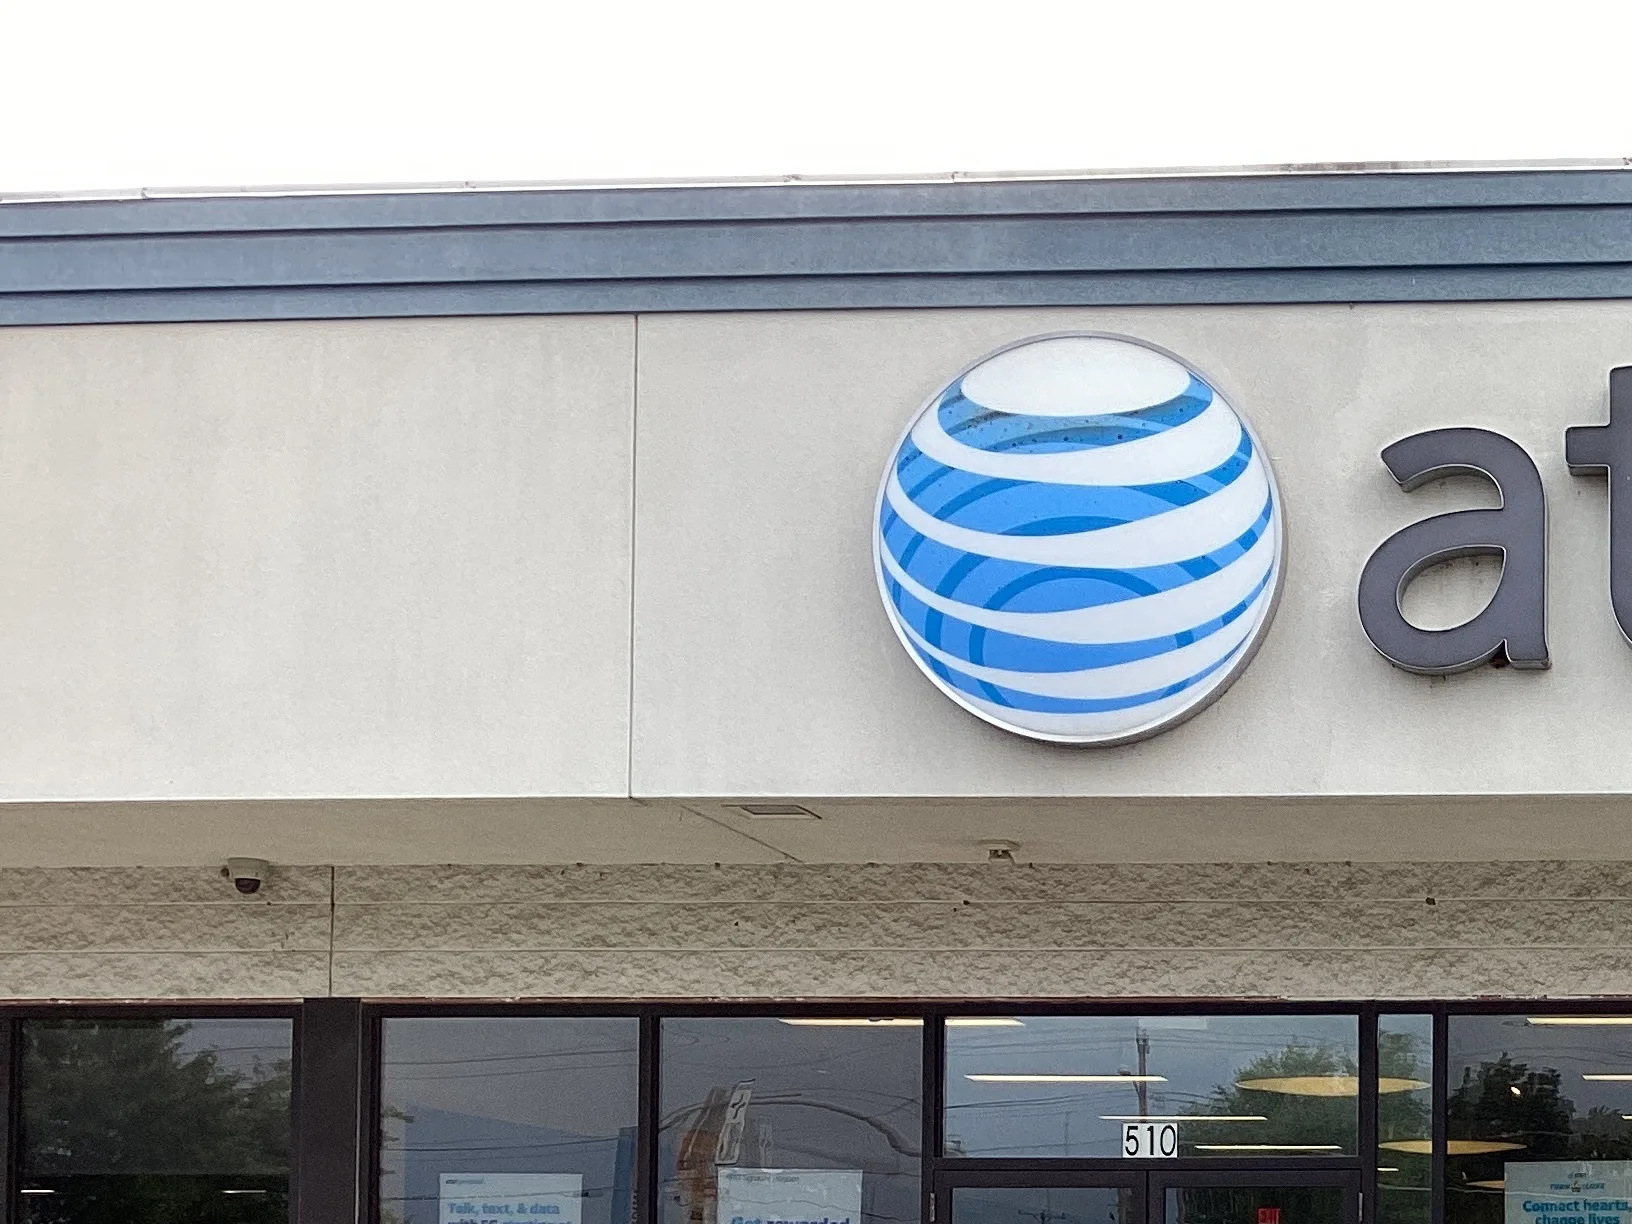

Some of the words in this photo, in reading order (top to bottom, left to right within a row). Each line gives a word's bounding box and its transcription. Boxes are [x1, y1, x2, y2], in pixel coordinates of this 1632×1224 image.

[1124, 1124, 1176, 1156] 510
[516, 1202, 527, 1214] &
[530, 1203, 560, 1214] data
[1522, 1200, 1580, 1212] Connect
[1583, 1199, 1632, 1212] hearts,
